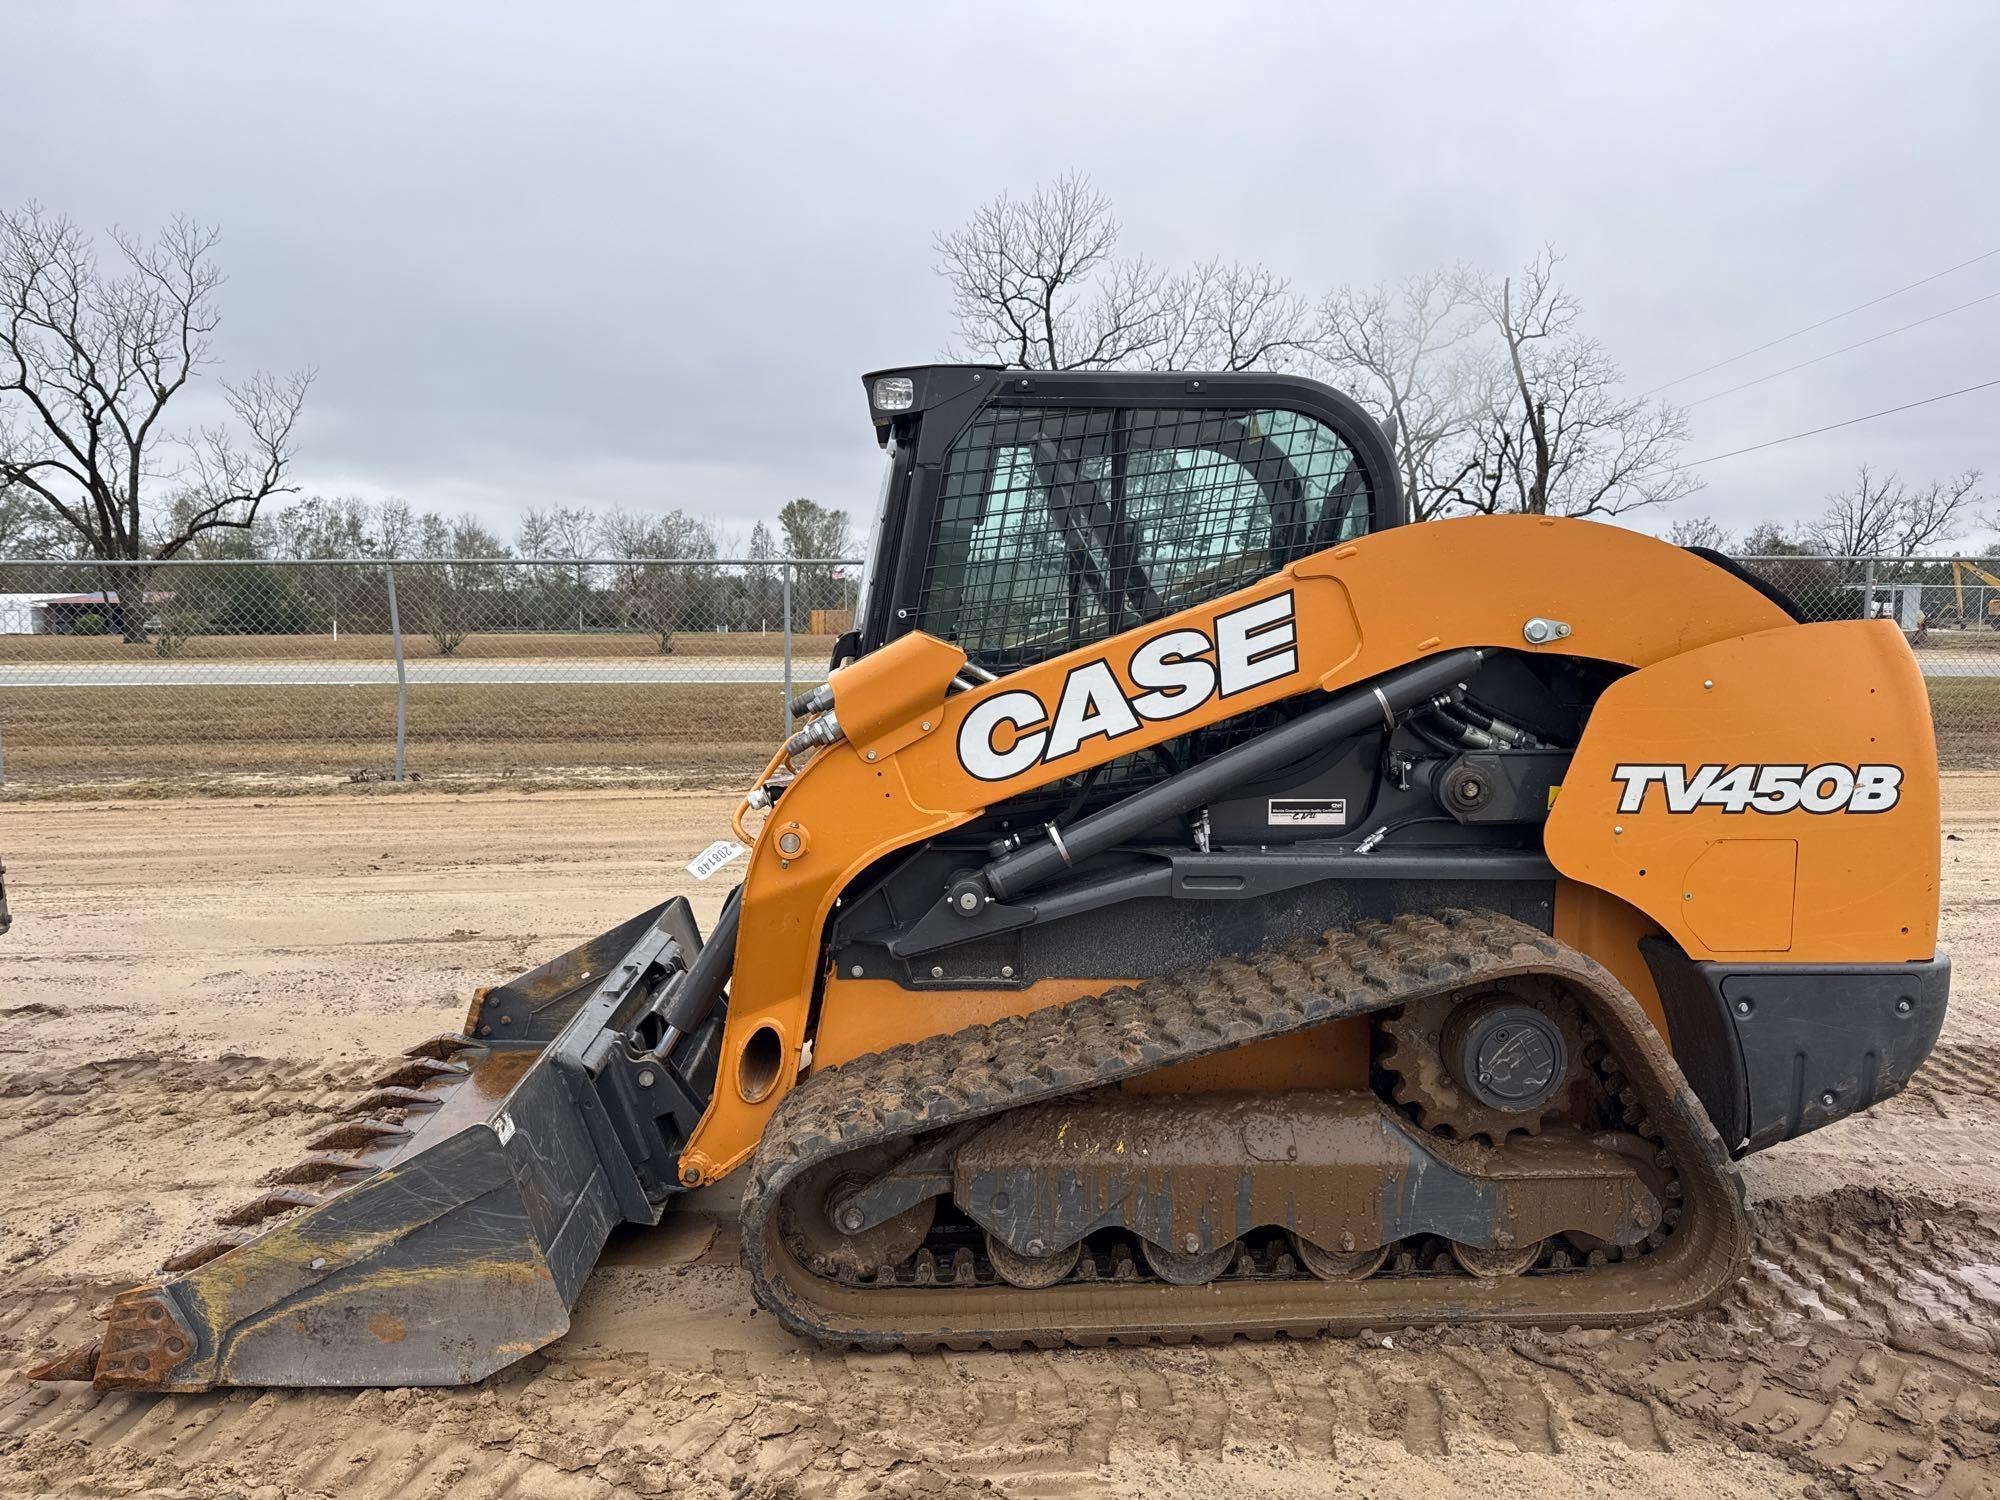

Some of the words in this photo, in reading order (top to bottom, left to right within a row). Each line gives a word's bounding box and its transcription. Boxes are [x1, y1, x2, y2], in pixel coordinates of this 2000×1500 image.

[956, 588, 1299, 782] CASE
[1611, 762, 1905, 815] TV450B
[697, 846, 732, 875] 208148
